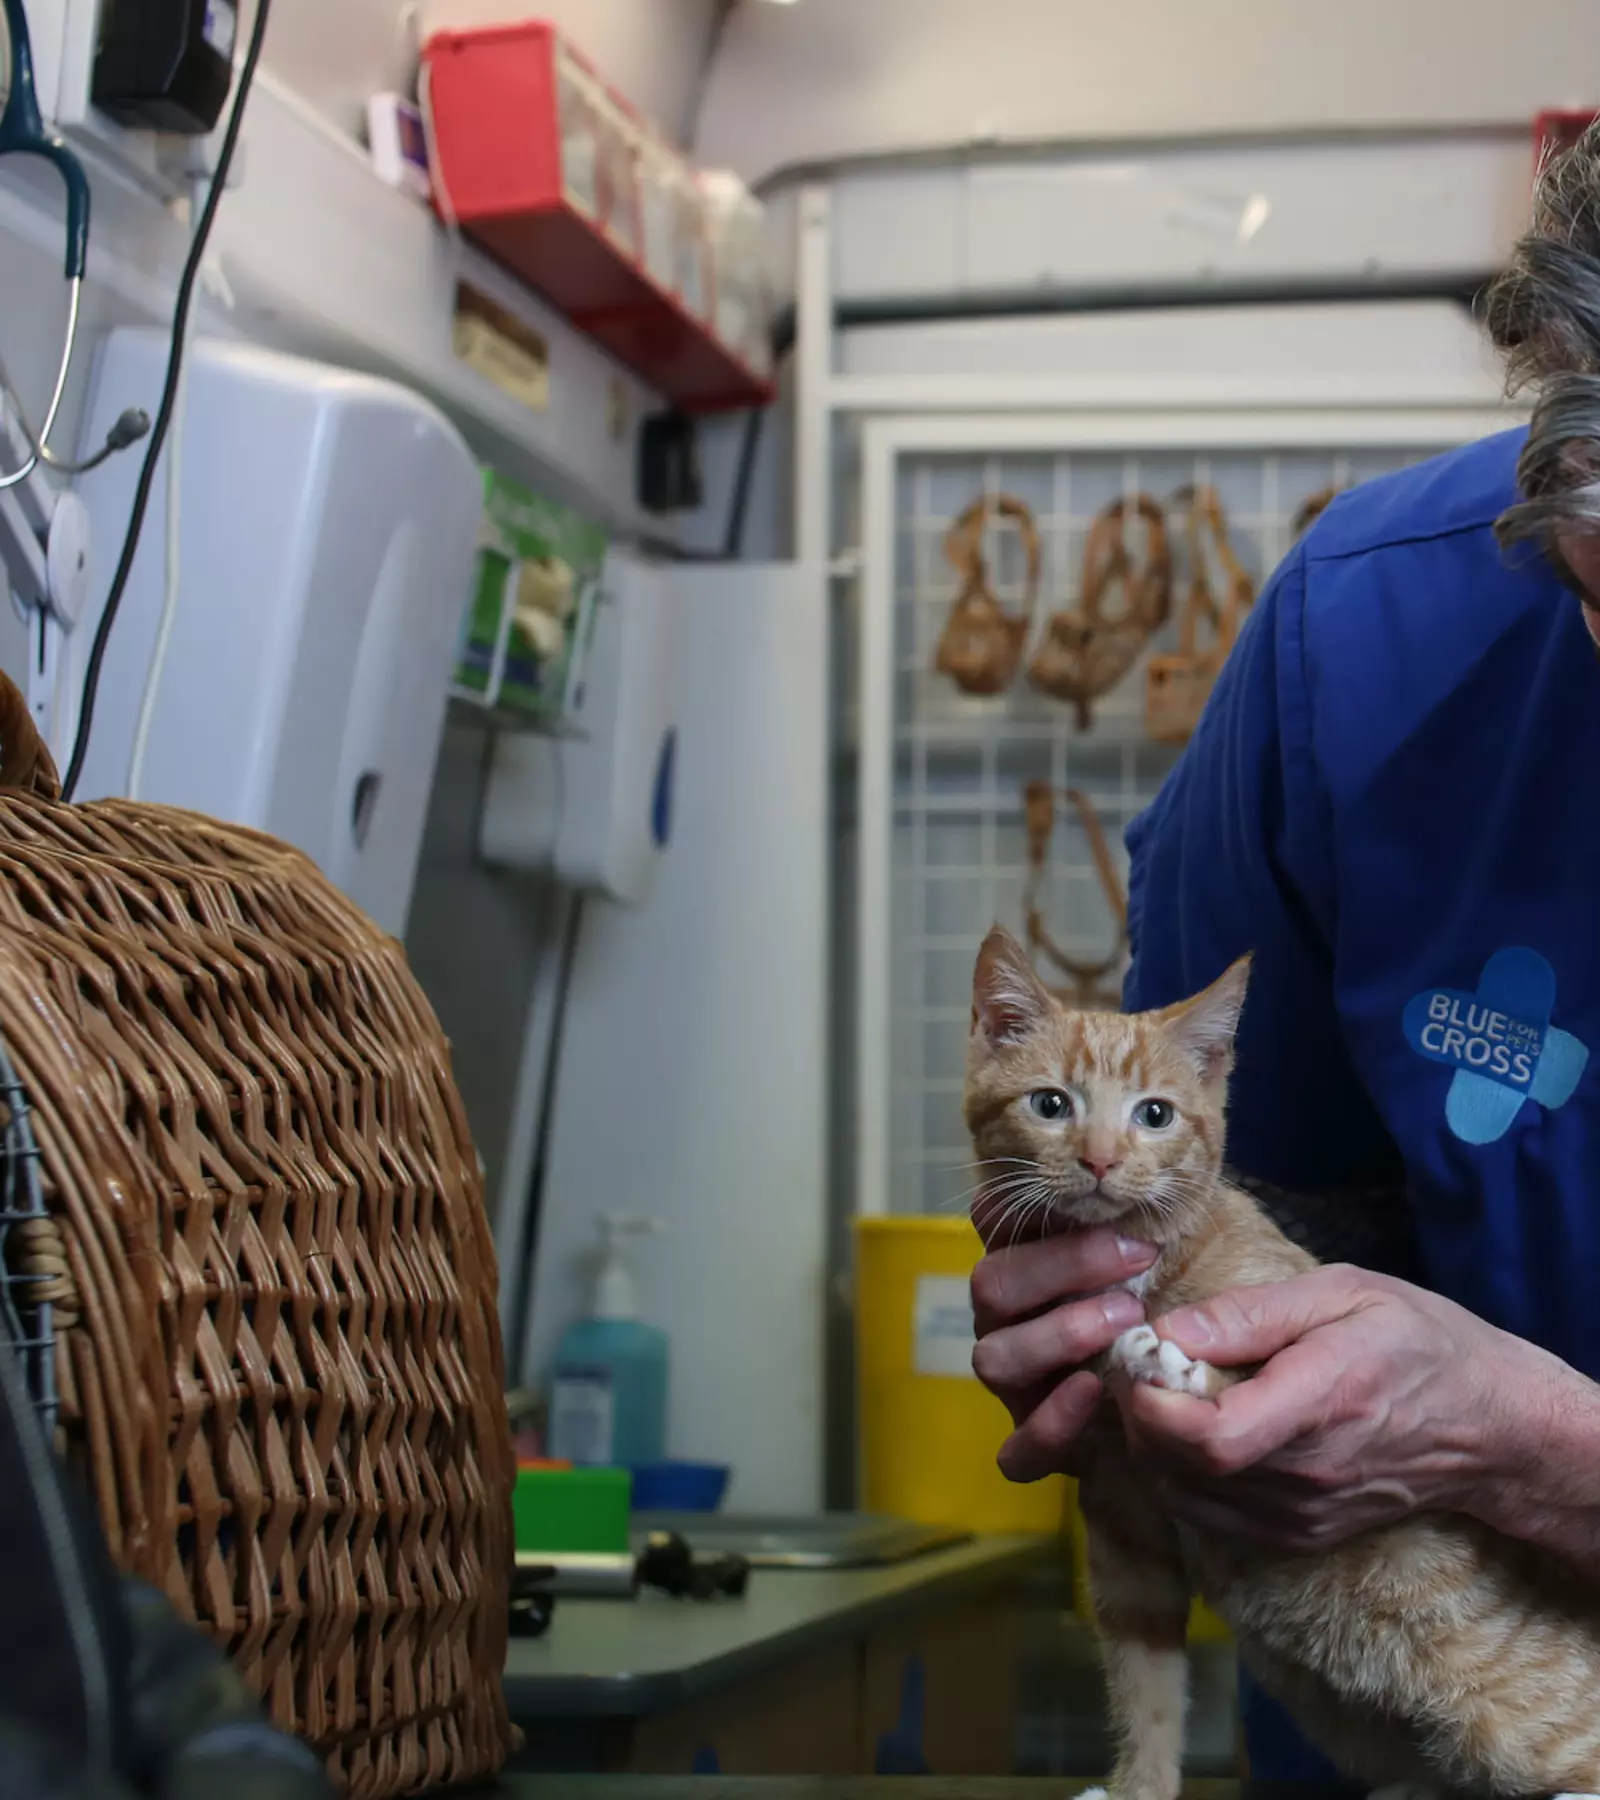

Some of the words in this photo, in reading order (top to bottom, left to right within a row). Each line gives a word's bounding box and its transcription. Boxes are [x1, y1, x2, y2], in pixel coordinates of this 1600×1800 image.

[1429, 994, 1508, 1040] BLUE
[1508, 1020, 1539, 1040] FOR
[1421, 1023, 1531, 1082] CROSS
[1504, 1034, 1540, 1056] PETS
